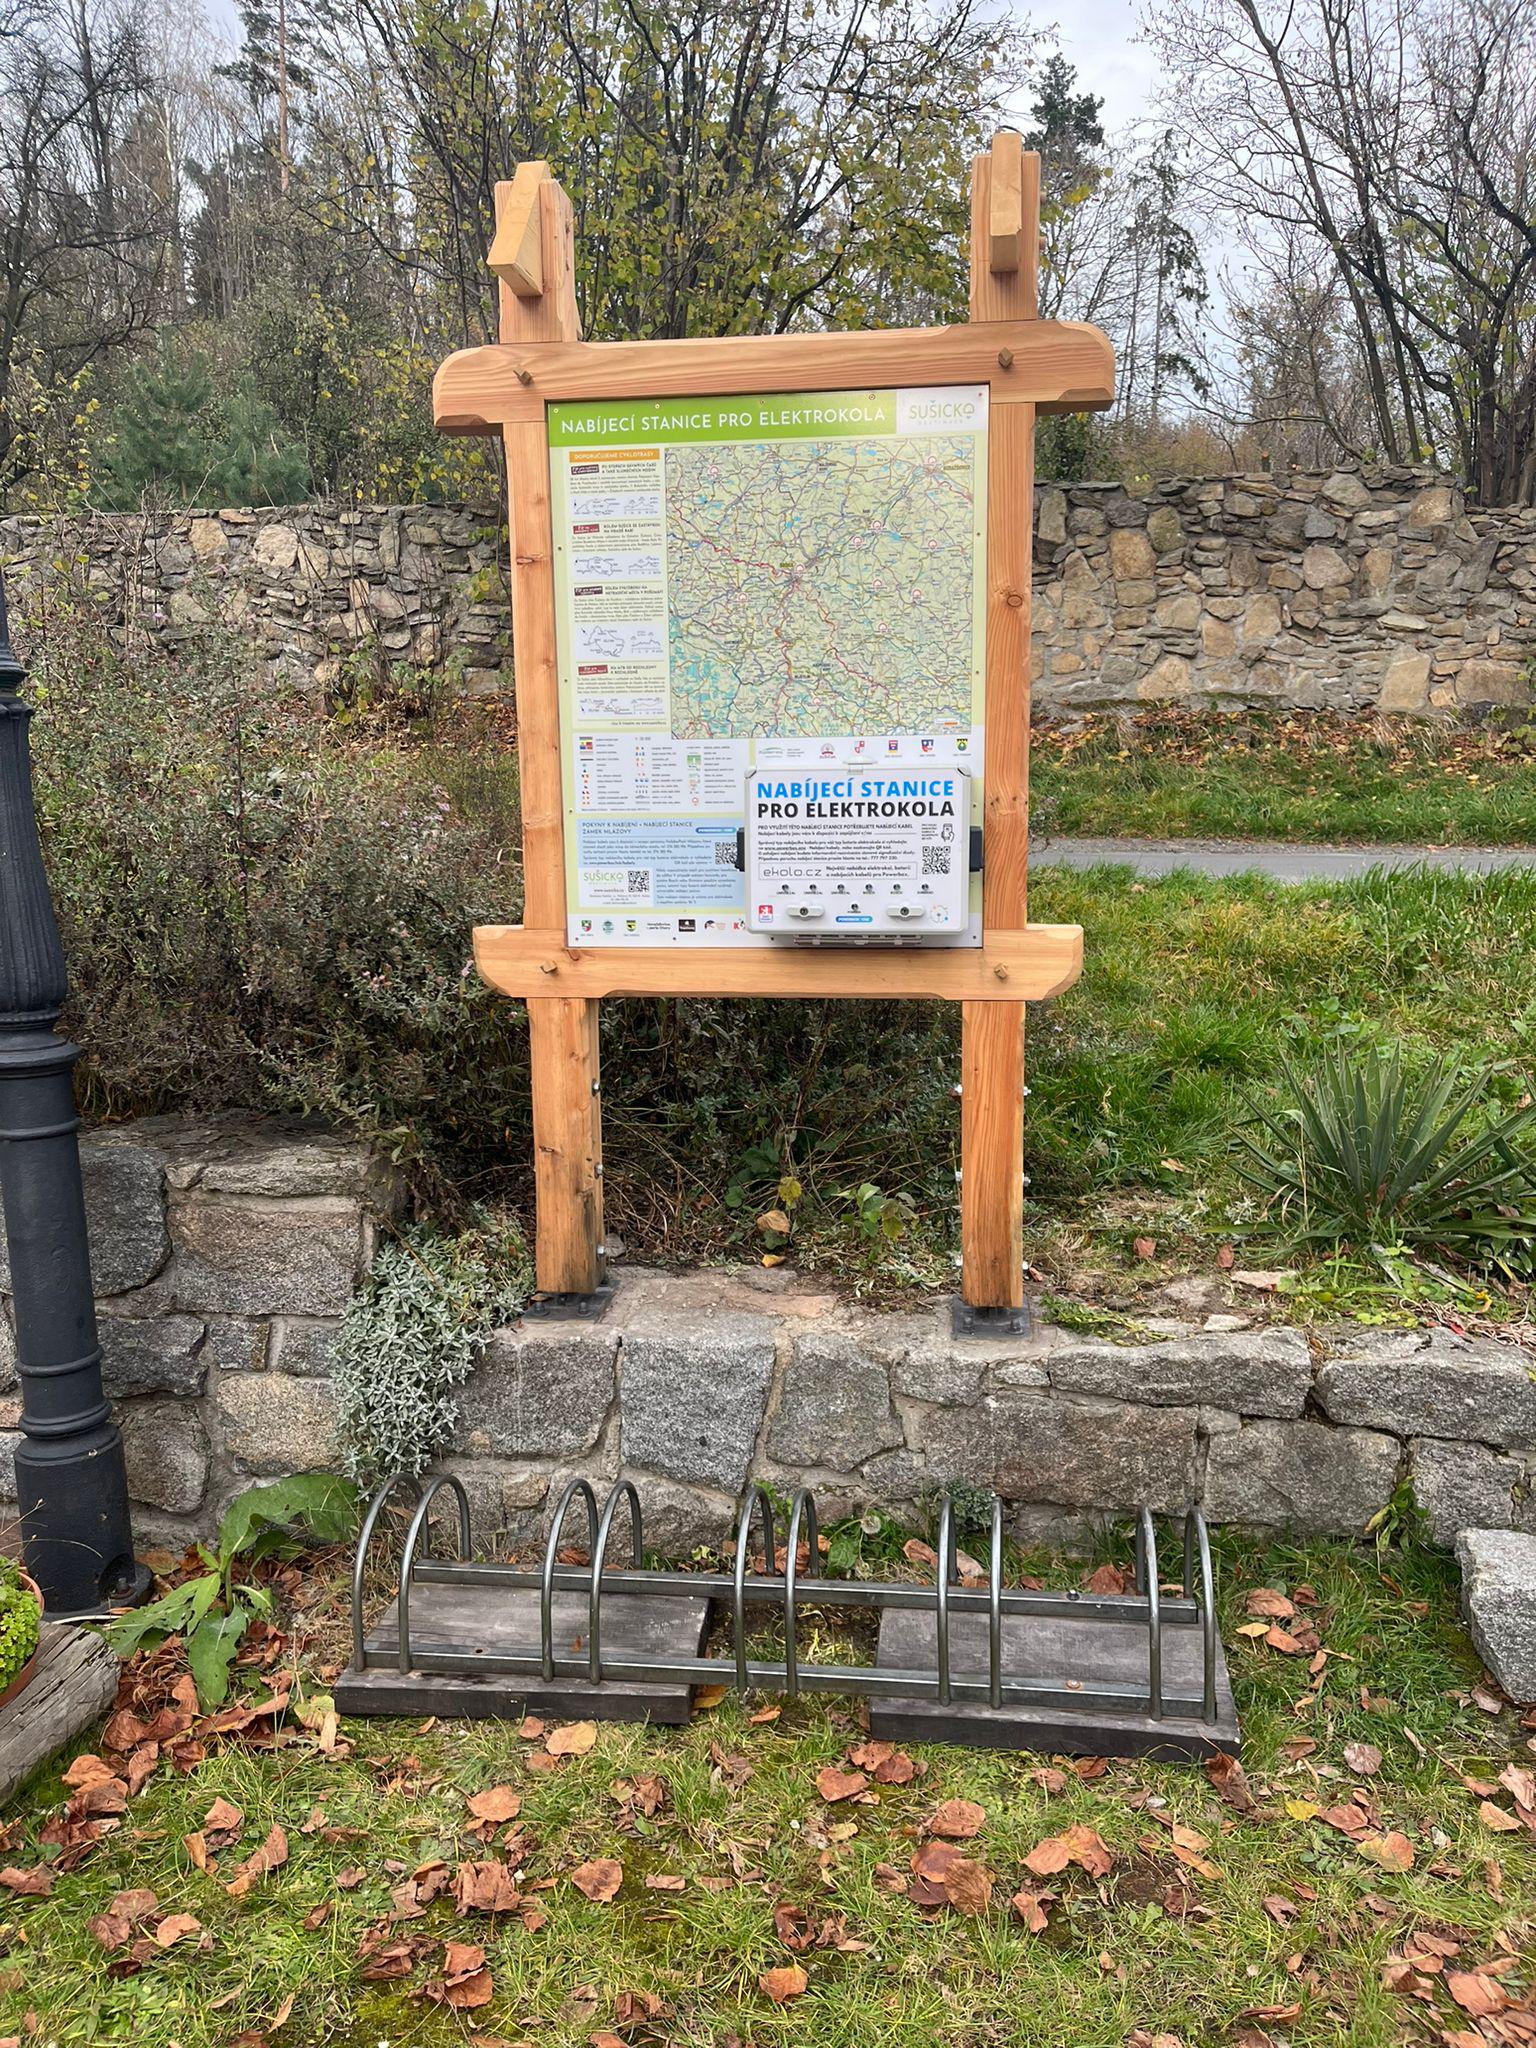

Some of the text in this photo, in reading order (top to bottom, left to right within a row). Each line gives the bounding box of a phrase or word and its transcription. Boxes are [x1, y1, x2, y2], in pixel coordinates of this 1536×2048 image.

[561, 408, 885, 434] NABÍJECÍ STANICE PRO ELEKTROKOLA
[757, 777, 954, 801] NABÍJECÍ STANICE
[758, 801, 955, 818] PRO ELEKTROKOLA
[763, 866, 822, 877] ekolo.cz
